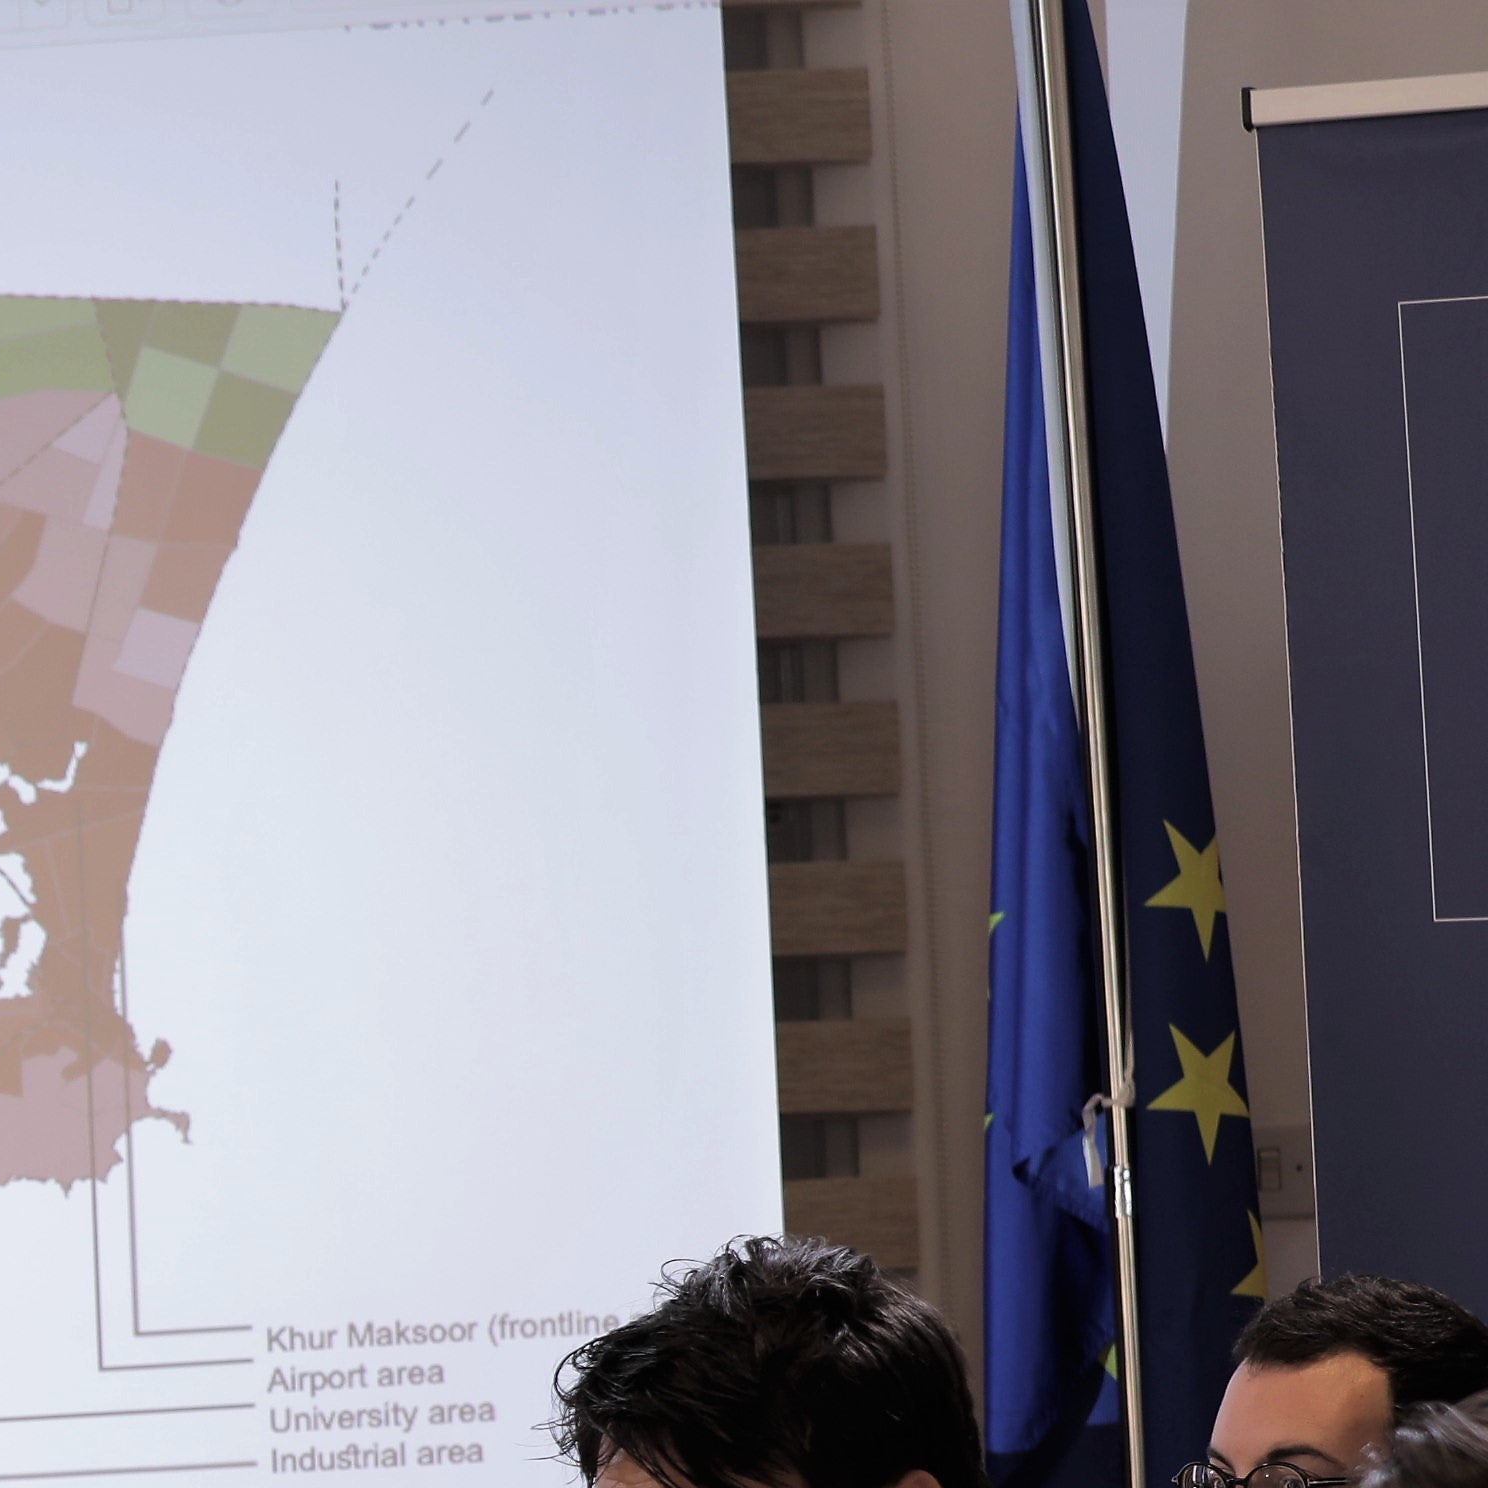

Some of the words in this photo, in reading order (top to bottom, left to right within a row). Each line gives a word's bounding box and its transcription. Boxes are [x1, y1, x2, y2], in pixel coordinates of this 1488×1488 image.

[266, 1323, 339, 1354] Khur
[347, 1317, 480, 1349] Maksoor
[487, 1309, 621, 1348] (frontline
[266, 1362, 369, 1399] Airport
[376, 1362, 445, 1388] area
[268, 1401, 420, 1435] University
[428, 1399, 497, 1424] area
[270, 1440, 407, 1475] Industrial
[416, 1440, 485, 1466] area
